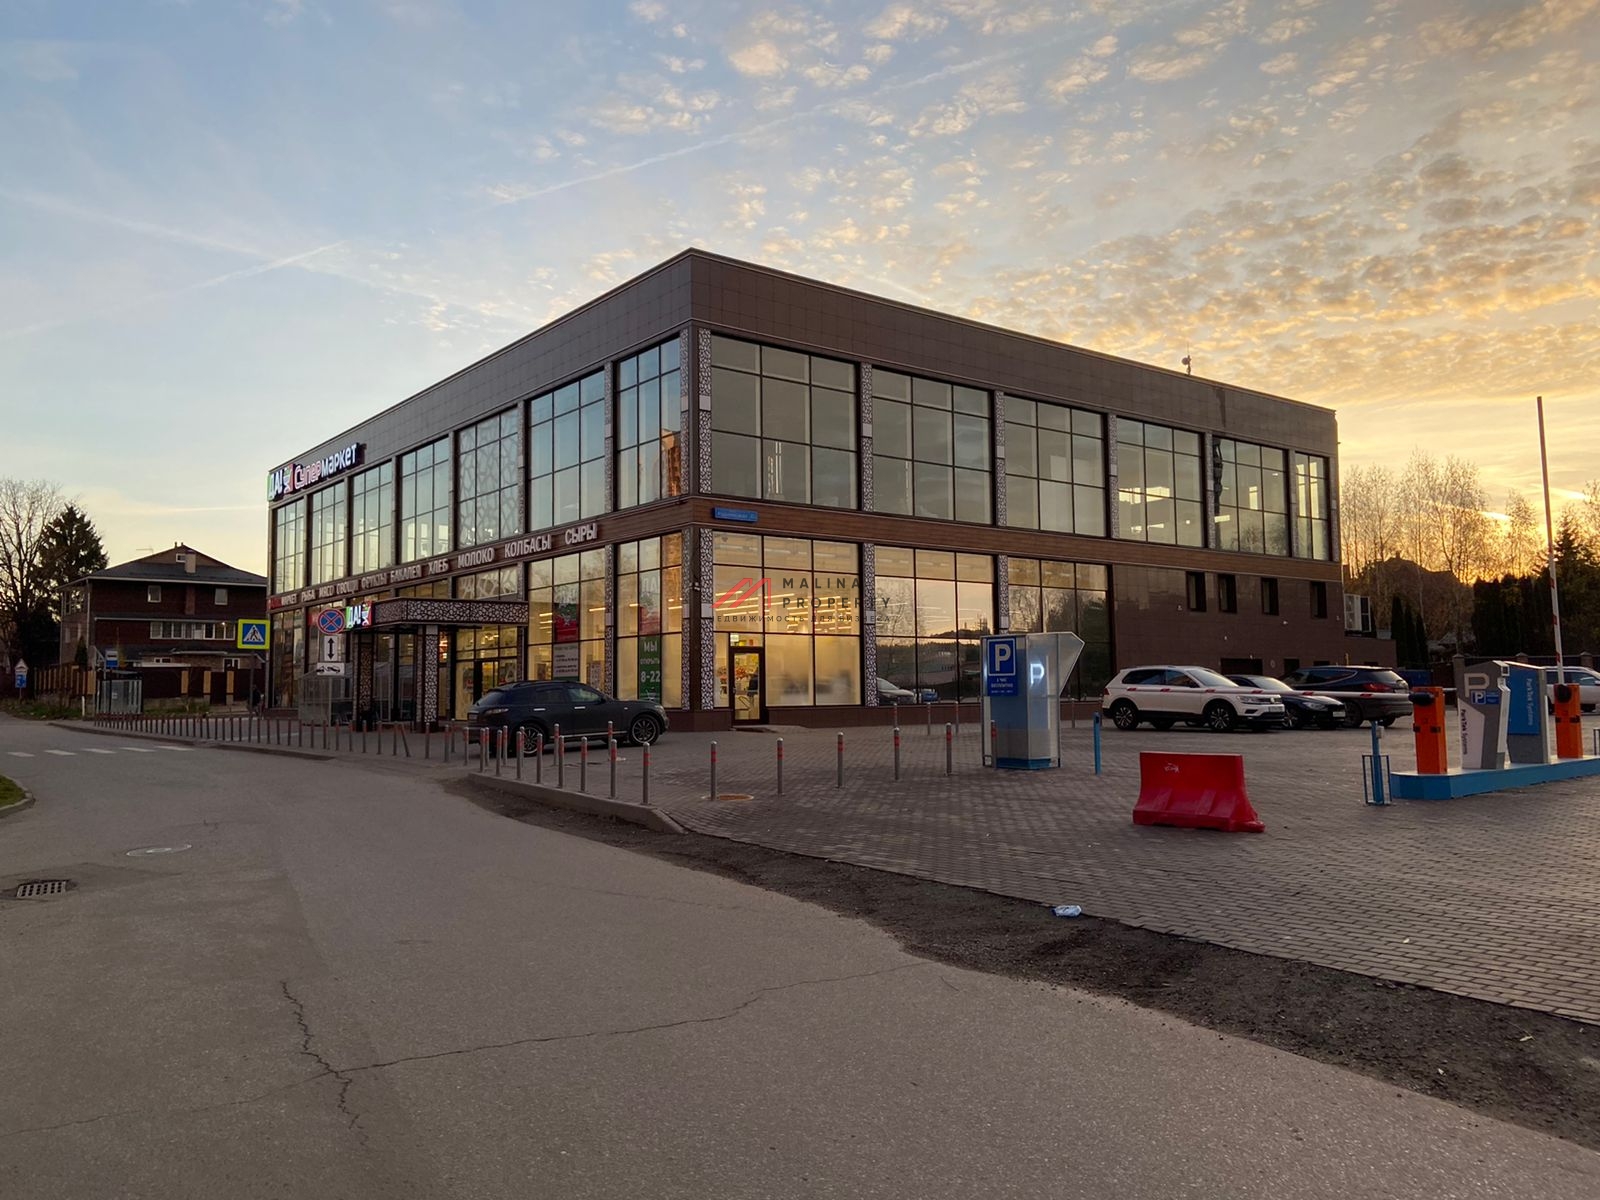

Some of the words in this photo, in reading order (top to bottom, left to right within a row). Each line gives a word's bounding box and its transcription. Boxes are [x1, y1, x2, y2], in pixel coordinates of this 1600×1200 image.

[294, 443, 358, 490] Супермаркет
[390, 565, 422, 584] БАКАЛЕЯ
[428, 558, 449, 576] ХЛЕБ
[457, 547, 495, 569] МОЛОКО
[504, 534, 551, 558] КОЛБАСЫ
[565, 523, 598, 545] СЫРЫ
[643, 640, 658, 652] МЫ
[640, 670, 660, 683] 8-22
